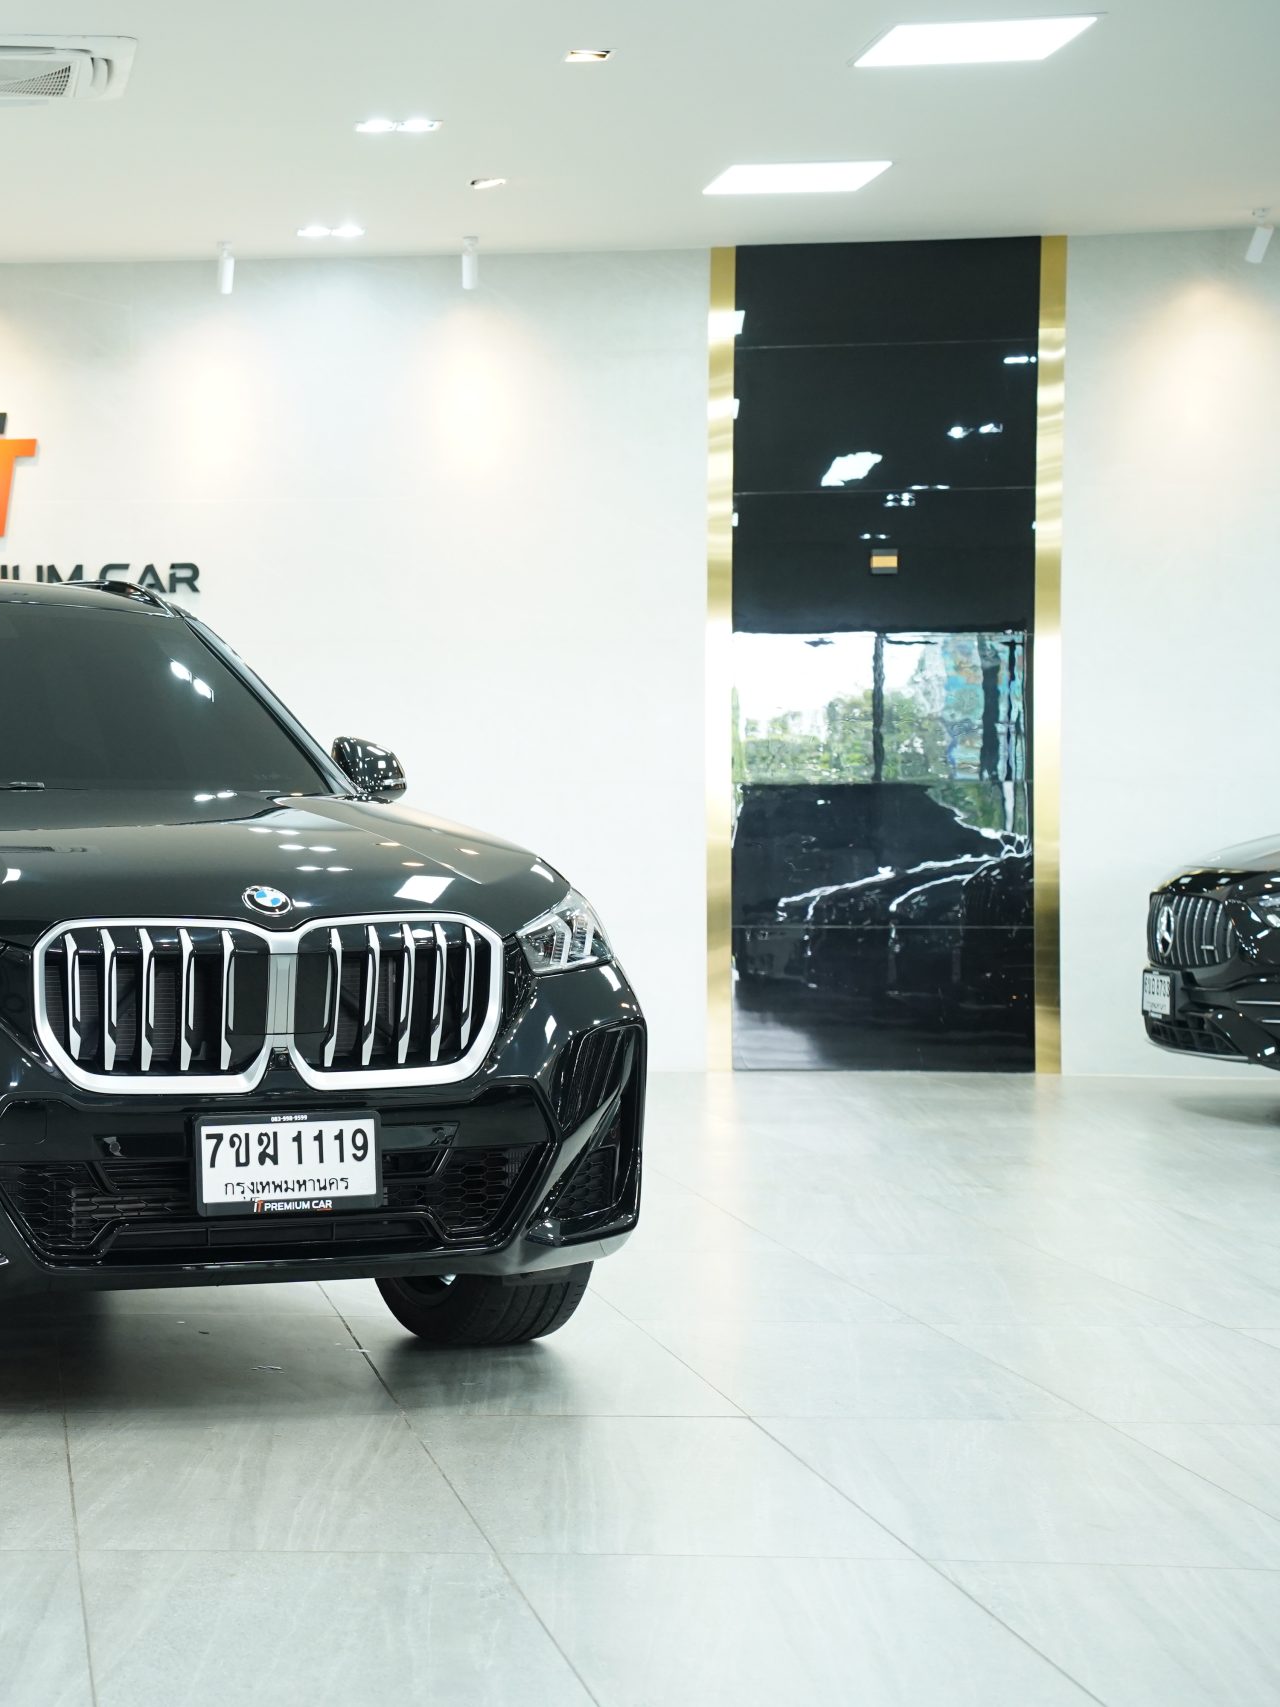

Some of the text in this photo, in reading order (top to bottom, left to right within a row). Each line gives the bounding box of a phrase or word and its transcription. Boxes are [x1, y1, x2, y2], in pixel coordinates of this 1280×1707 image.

[205, 1128, 369, 1168] 7ขฆ 1119
[224, 1177, 350, 1200] กรุงเทพมหานคร
[264, 1201, 311, 1212] PREMIUM
[311, 1200, 333, 1209] CAR
